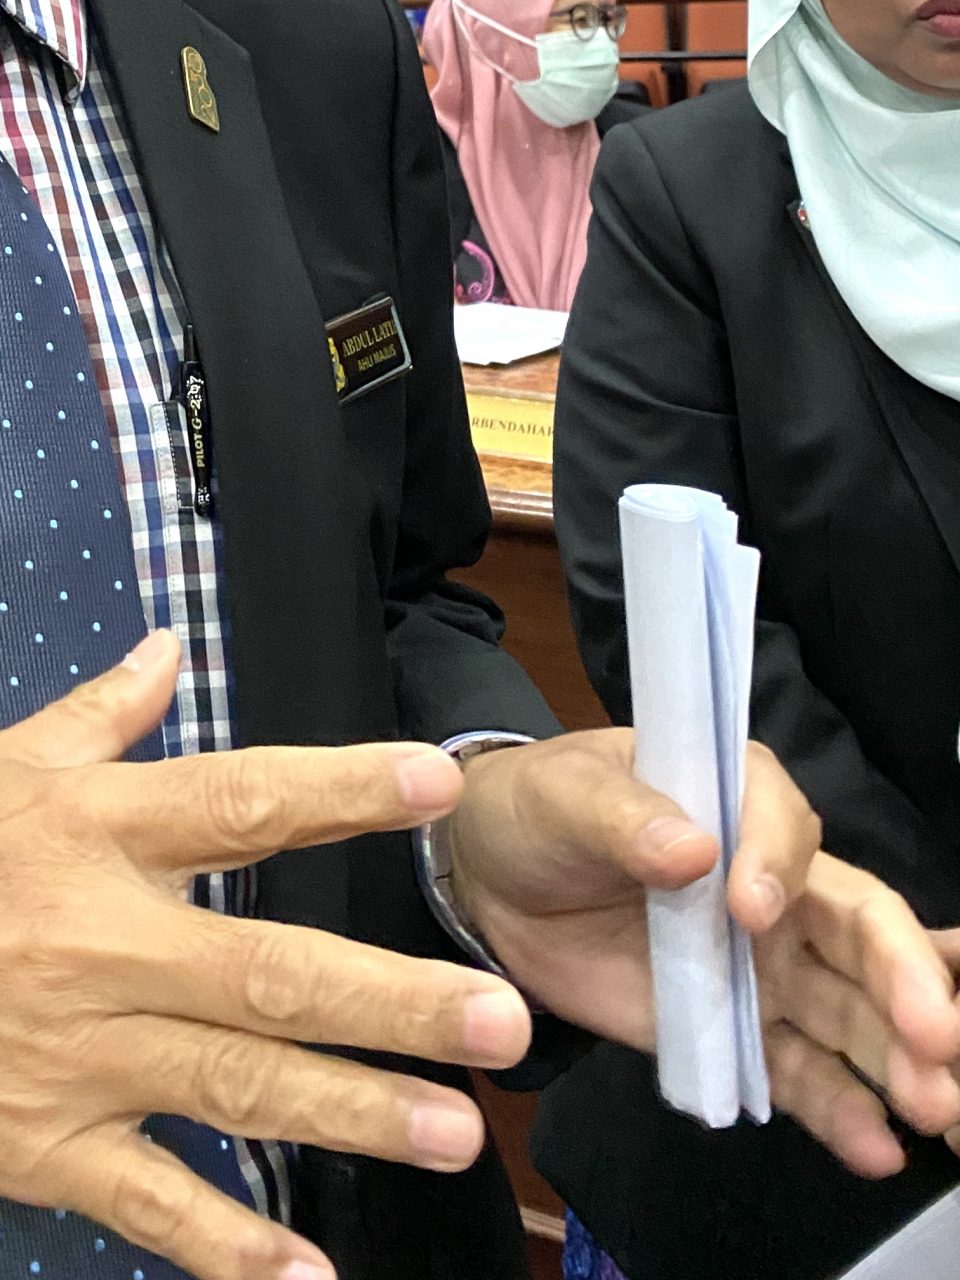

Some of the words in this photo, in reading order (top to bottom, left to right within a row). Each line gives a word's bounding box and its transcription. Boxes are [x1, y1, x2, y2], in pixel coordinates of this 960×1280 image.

[342, 330, 374, 358] ABDUL
[190, 399, 203, 430] G-2
[193, 432, 206, 468] PILOT
